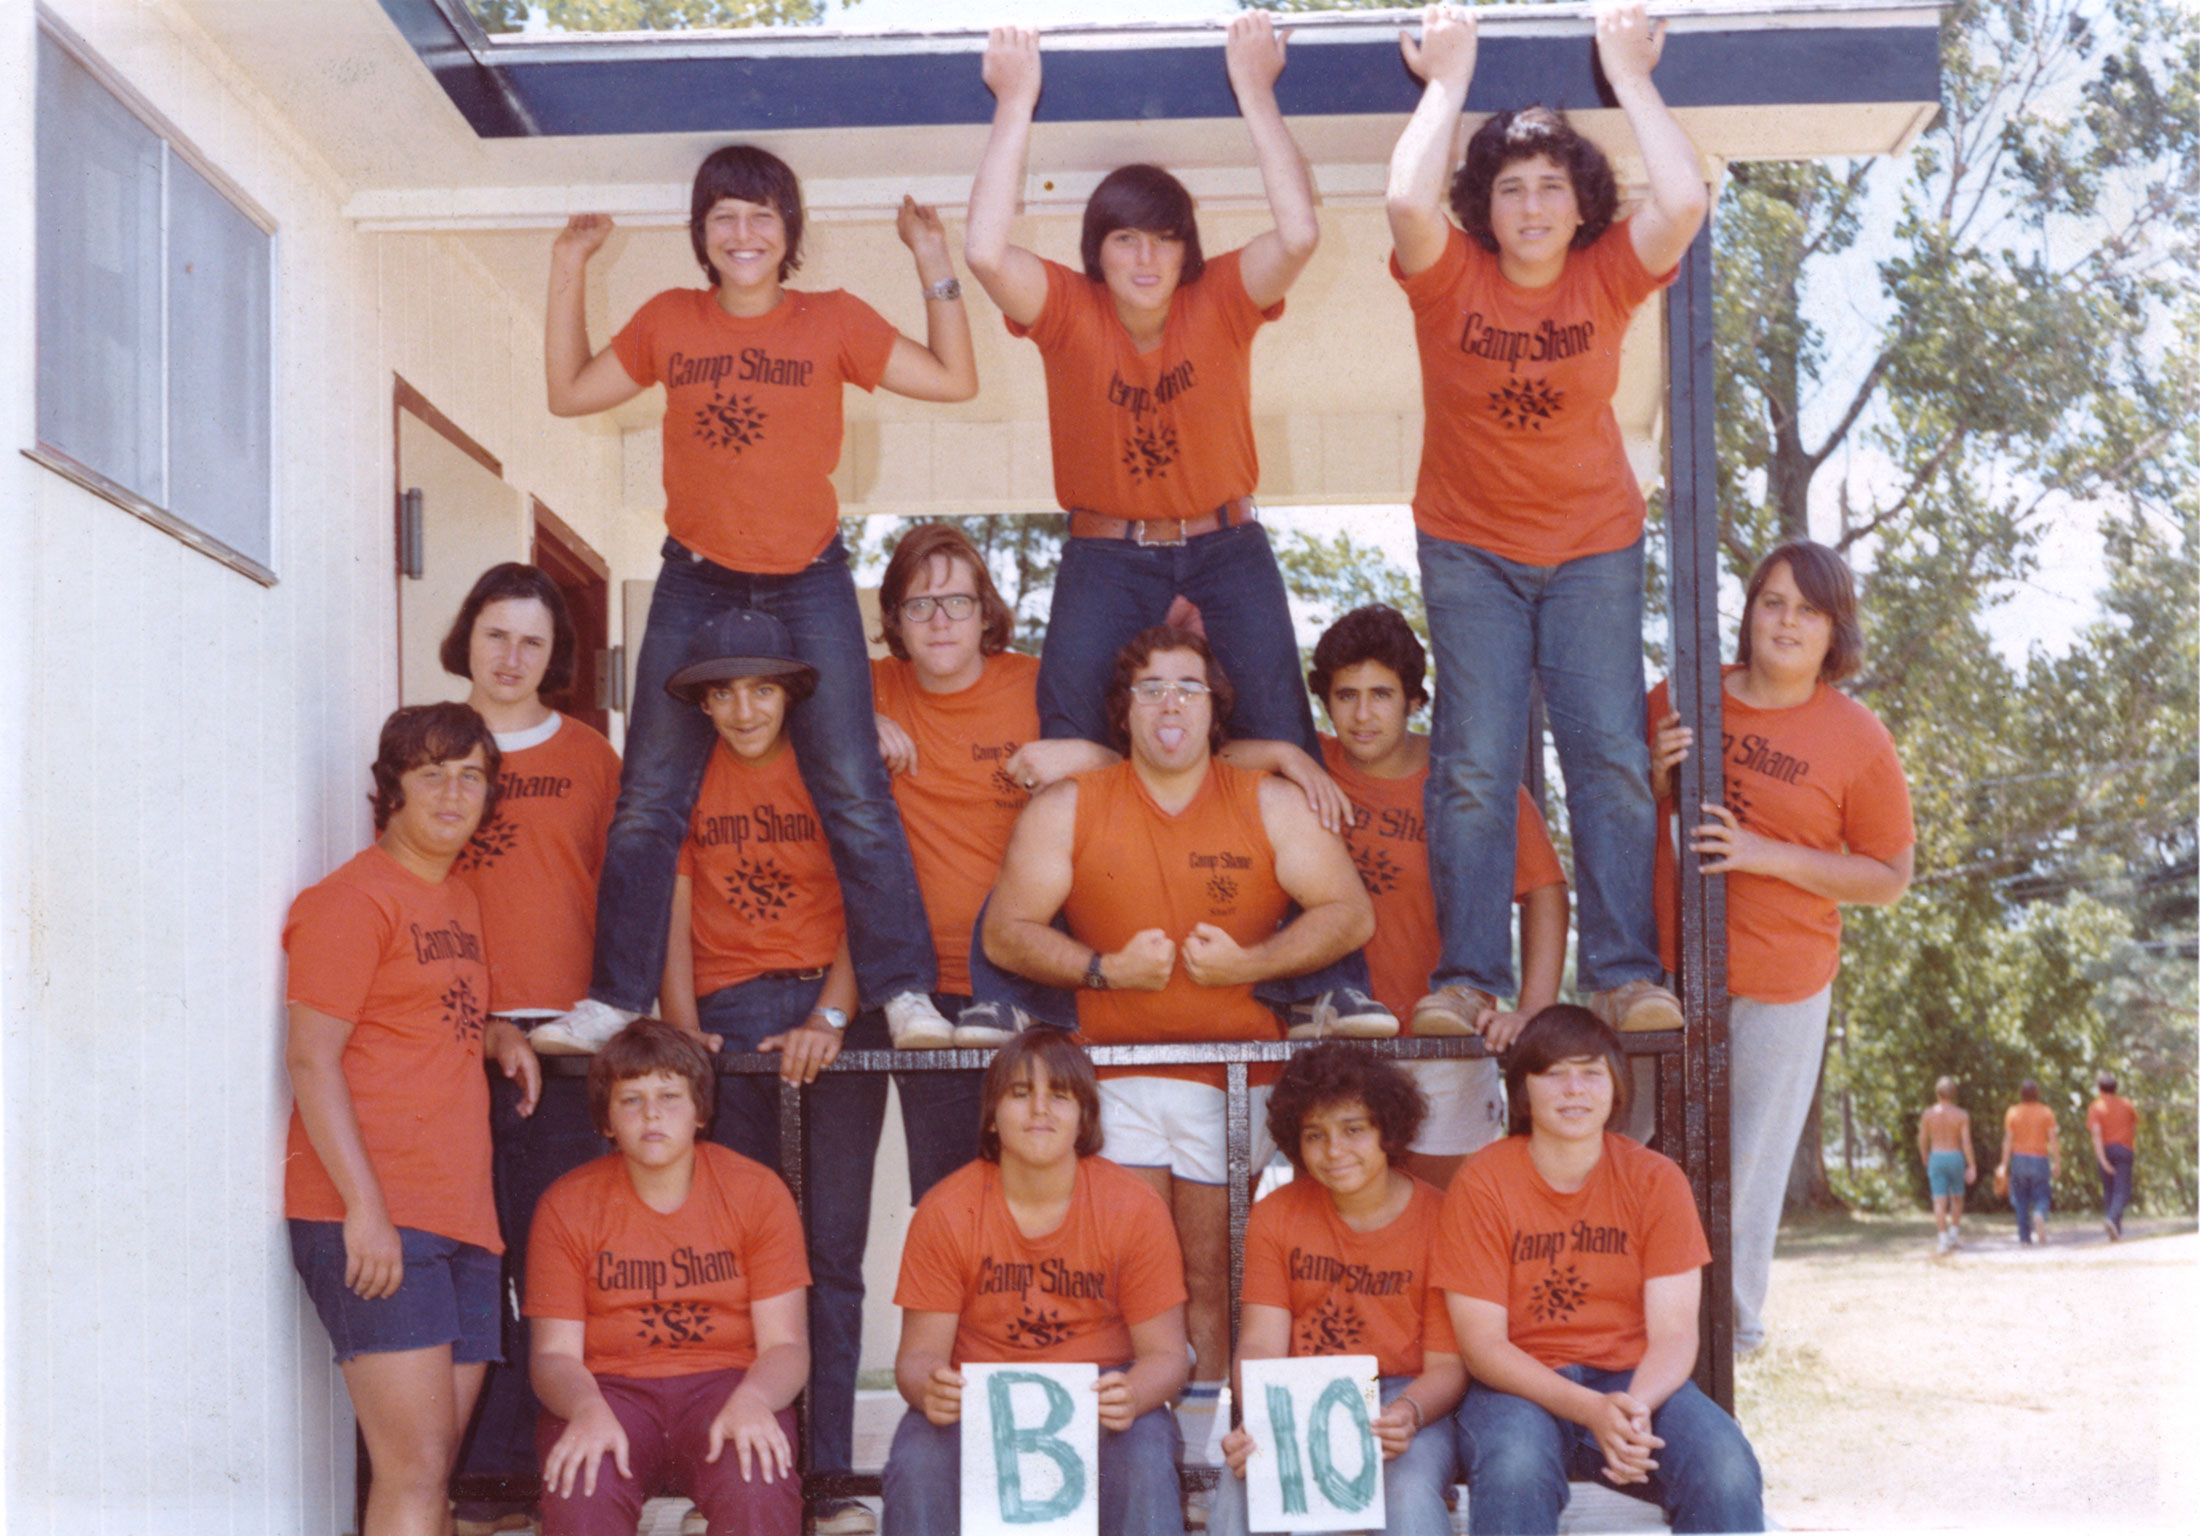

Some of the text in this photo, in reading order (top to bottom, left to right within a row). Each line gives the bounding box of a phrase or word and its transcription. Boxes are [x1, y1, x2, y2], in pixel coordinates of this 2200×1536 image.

[1461, 312, 1596, 373] Camp Shane
[668, 348, 813, 389] Camp Shane
[1734, 734, 1809, 786] Shane
[597, 1251, 667, 1300] Camp
[978, 1256, 1034, 1301] Camp
[1289, 1247, 1346, 1292] Camp
[988, 1371, 1087, 1524] B
[1265, 1376, 1379, 1515] 10
